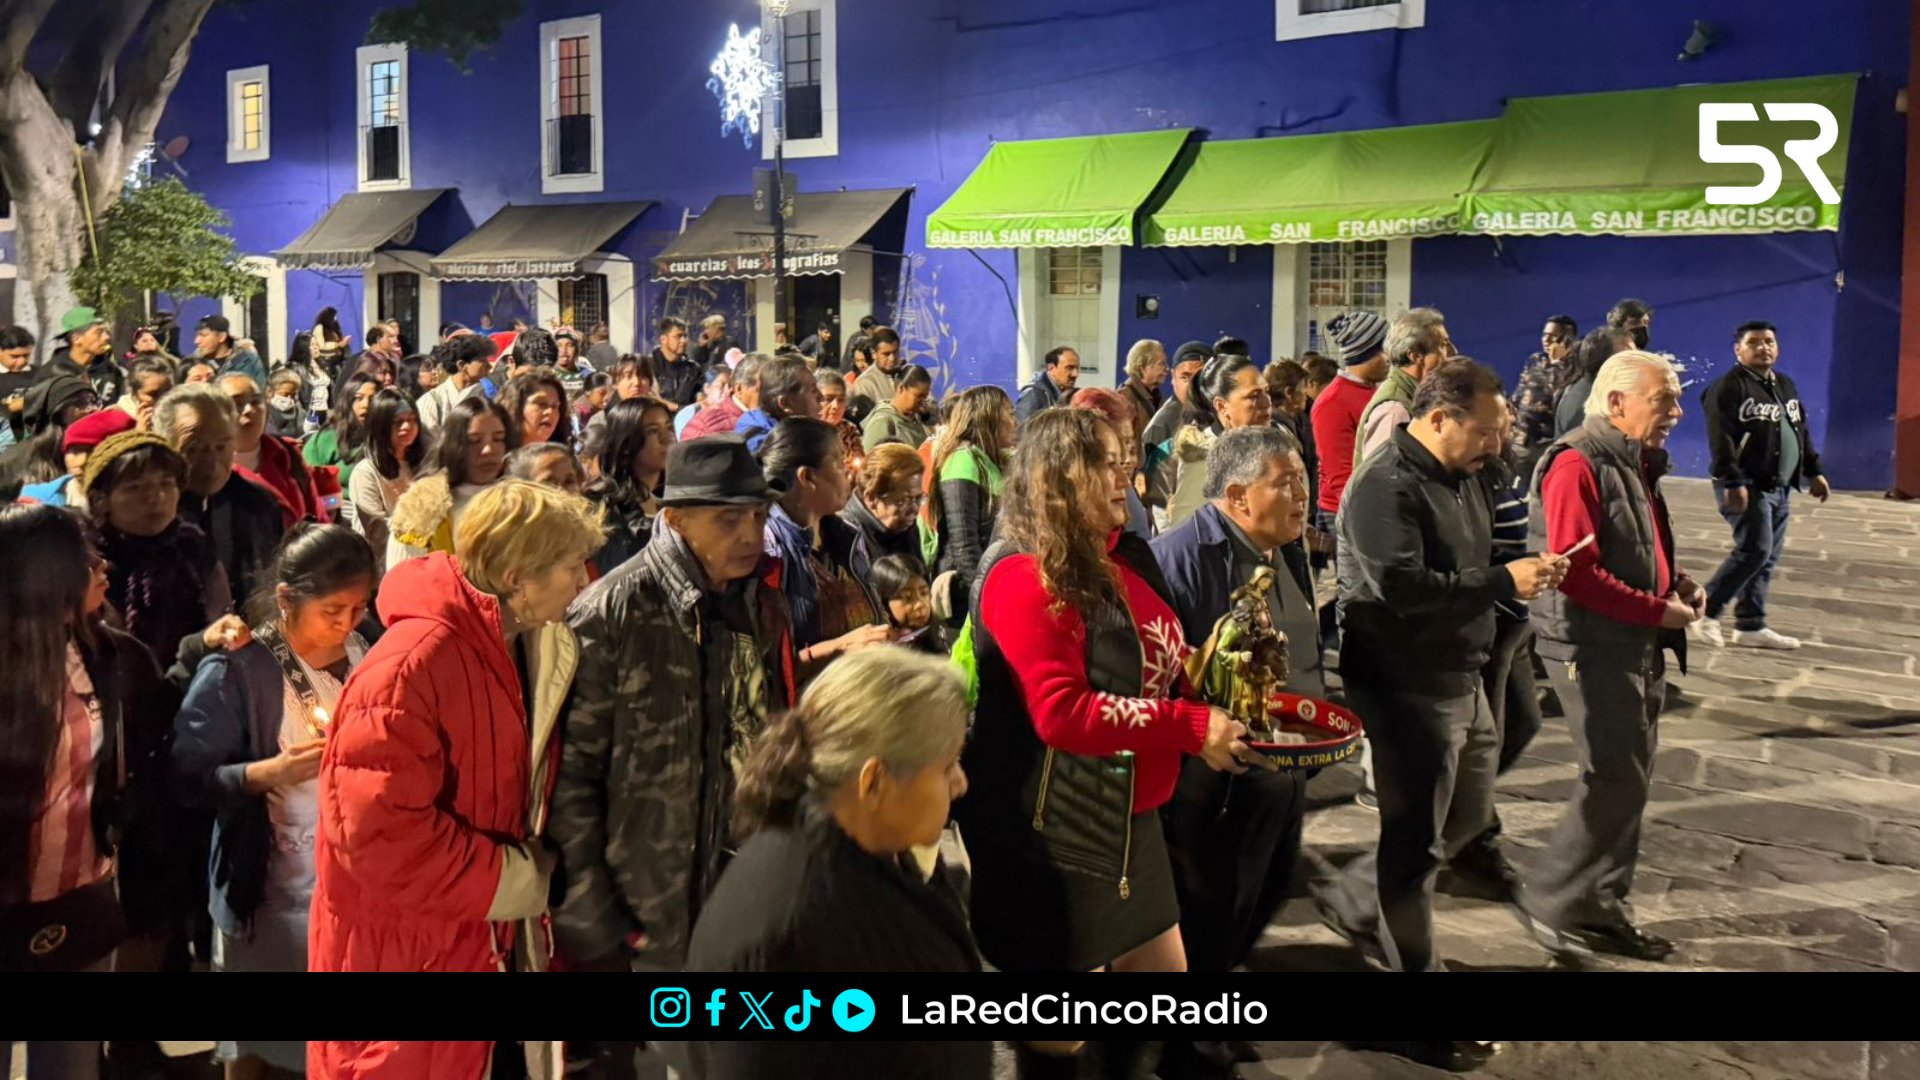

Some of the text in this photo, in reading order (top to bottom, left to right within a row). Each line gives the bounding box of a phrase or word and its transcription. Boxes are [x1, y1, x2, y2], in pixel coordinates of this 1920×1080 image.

[1164, 214, 1460, 243] GALERIA SAN FRANCISCO
[1472, 206, 1816, 231] GALERIA SAN FRANCISCO
[930, 225, 1130, 246] GALERIA SAN FRANCISCO
[1299, 752, 1333, 766] EXTRA
[1335, 748, 1345, 760] LA
